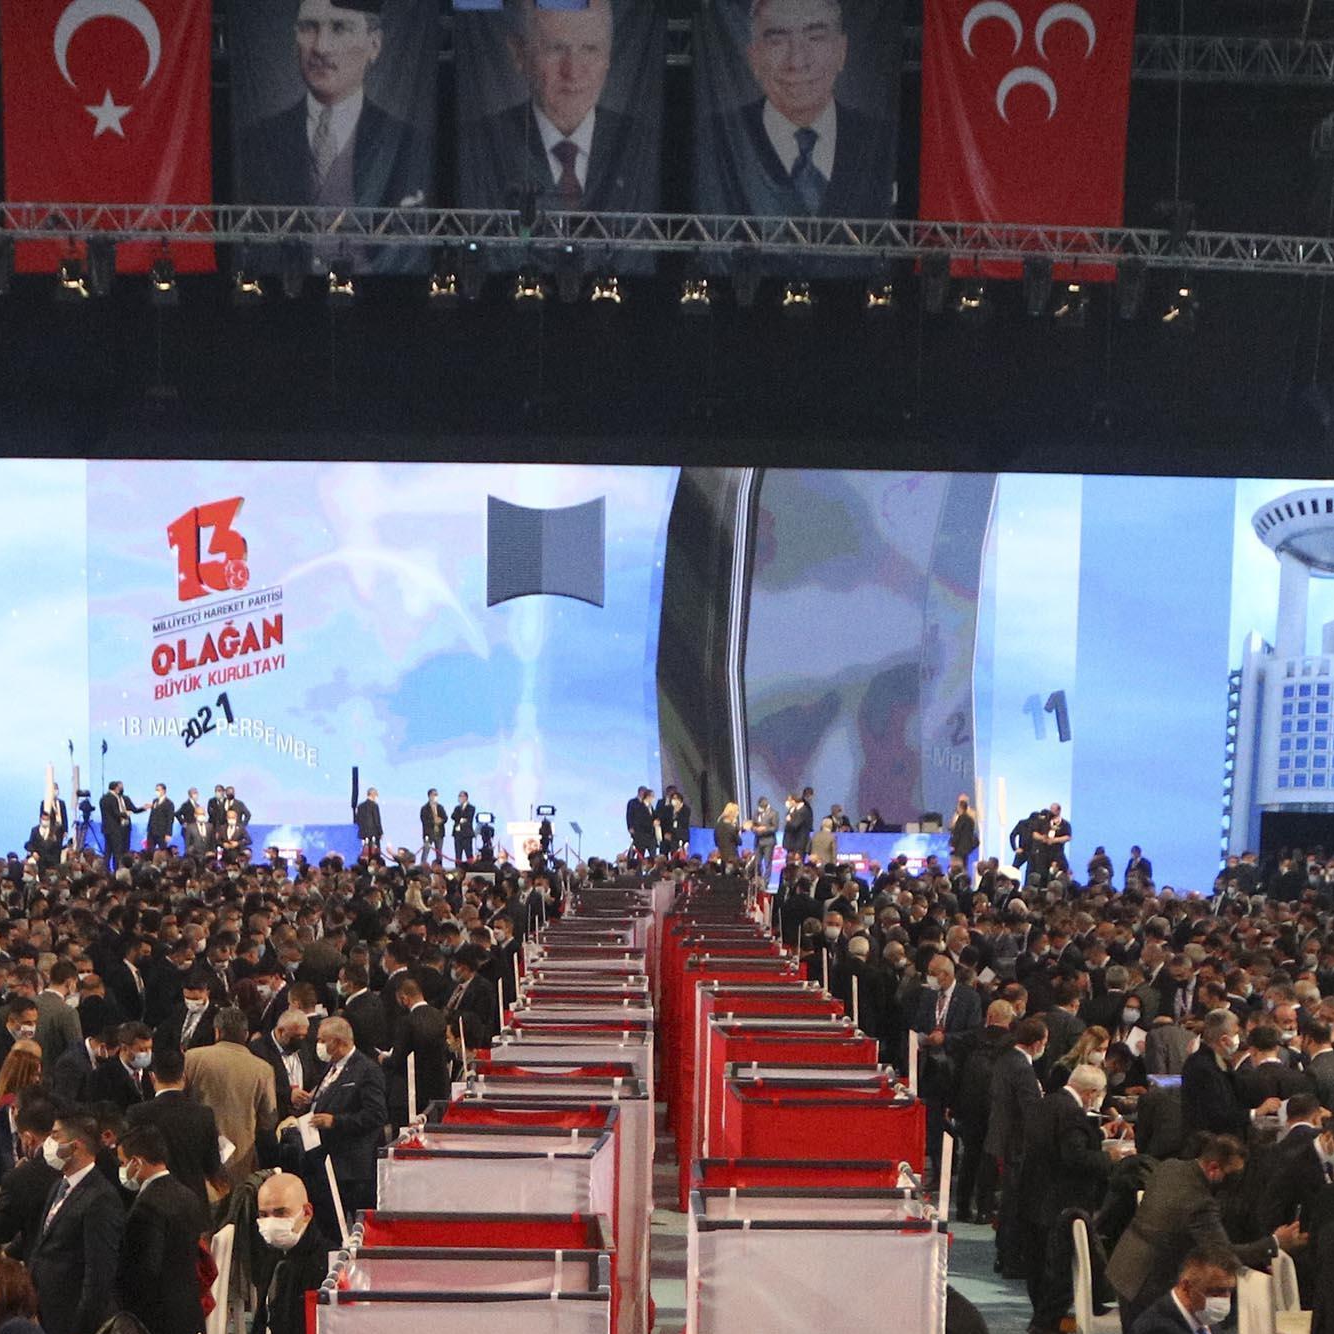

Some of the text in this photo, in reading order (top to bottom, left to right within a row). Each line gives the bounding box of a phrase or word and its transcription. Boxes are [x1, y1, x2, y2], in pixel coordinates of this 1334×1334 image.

[167, 496, 248, 602] 13
[152, 589, 283, 633] MİLLİYETÇİ HAREKET PARTİSİ
[151, 613, 284, 676] OLAĞAN
[154, 654, 285, 700] BÜYÜK KURULTAYI
[118, 716, 141, 736] 18
[216, 717, 319, 768] PERŞEMBE
[181, 691, 234, 748] 2021
